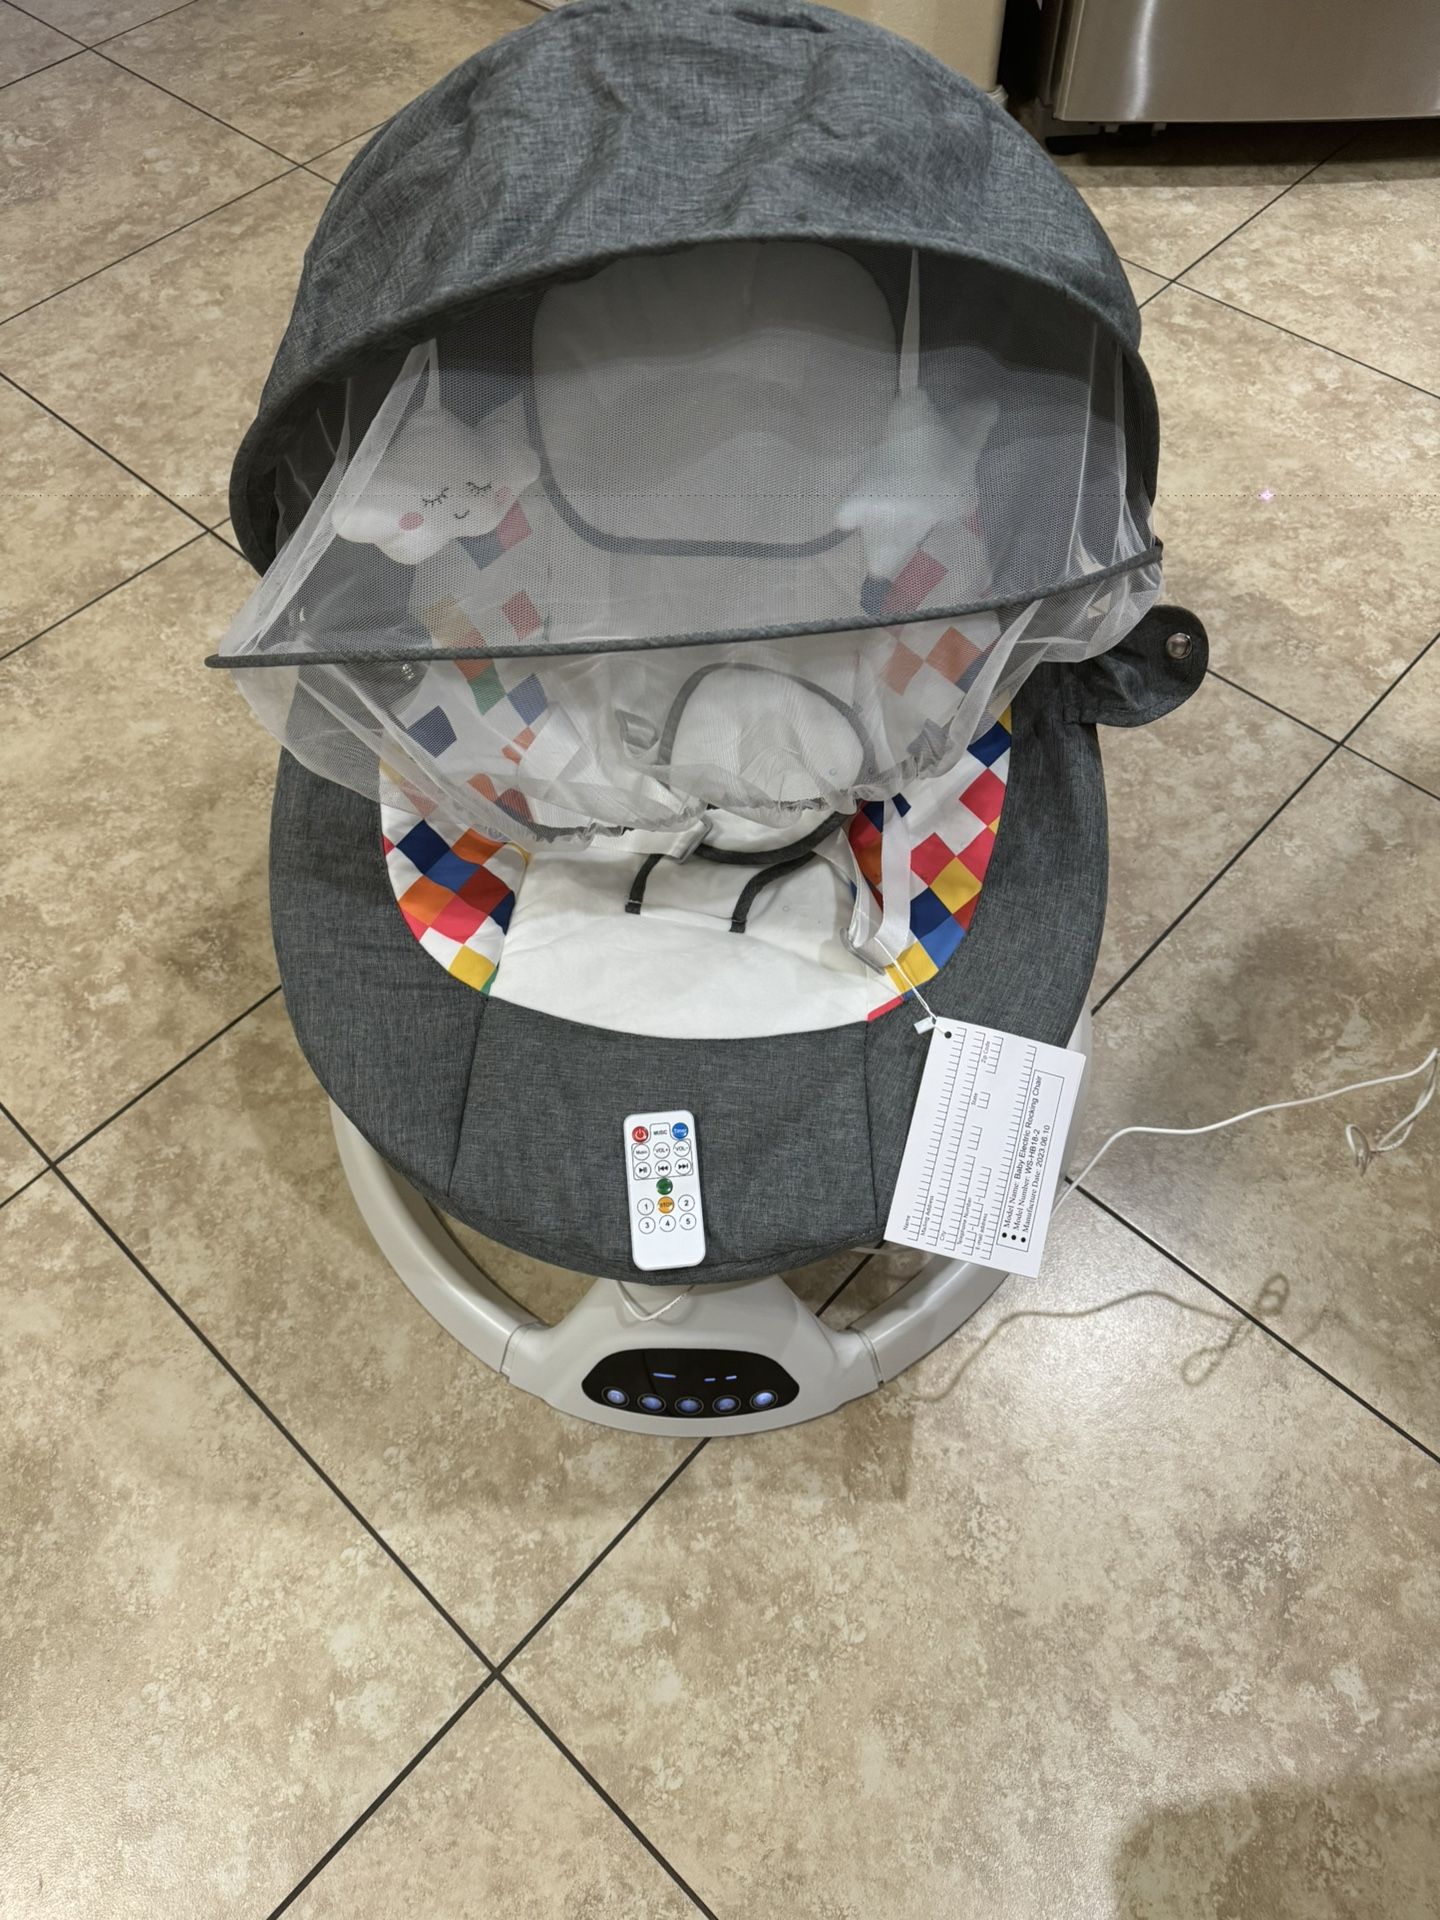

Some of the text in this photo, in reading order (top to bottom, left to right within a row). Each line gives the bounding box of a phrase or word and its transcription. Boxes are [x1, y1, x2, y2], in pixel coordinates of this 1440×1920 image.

[982, 1040, 990, 1054] Code
[970, 1092, 978, 1105] State
[1003, 1075, 1042, 1228] Model Name: Baby Electric Rocking Chair
[1012, 1128, 1040, 1230] Model Number: WS-HB18-2
[1021, 1124, 1051, 1232] Manufacture Date: 2023.06.10
[683, 1199, 689, 1207] 2
[920, 1194, 934, 1235] Mailing Address
[645, 1221, 650, 1229] 3
[665, 1219, 670, 1227] 4
[685, 1217, 691, 1225] 5
[956, 1196, 972, 1245] Telephone Number
[975, 1212, 987, 1250] E-mail address
